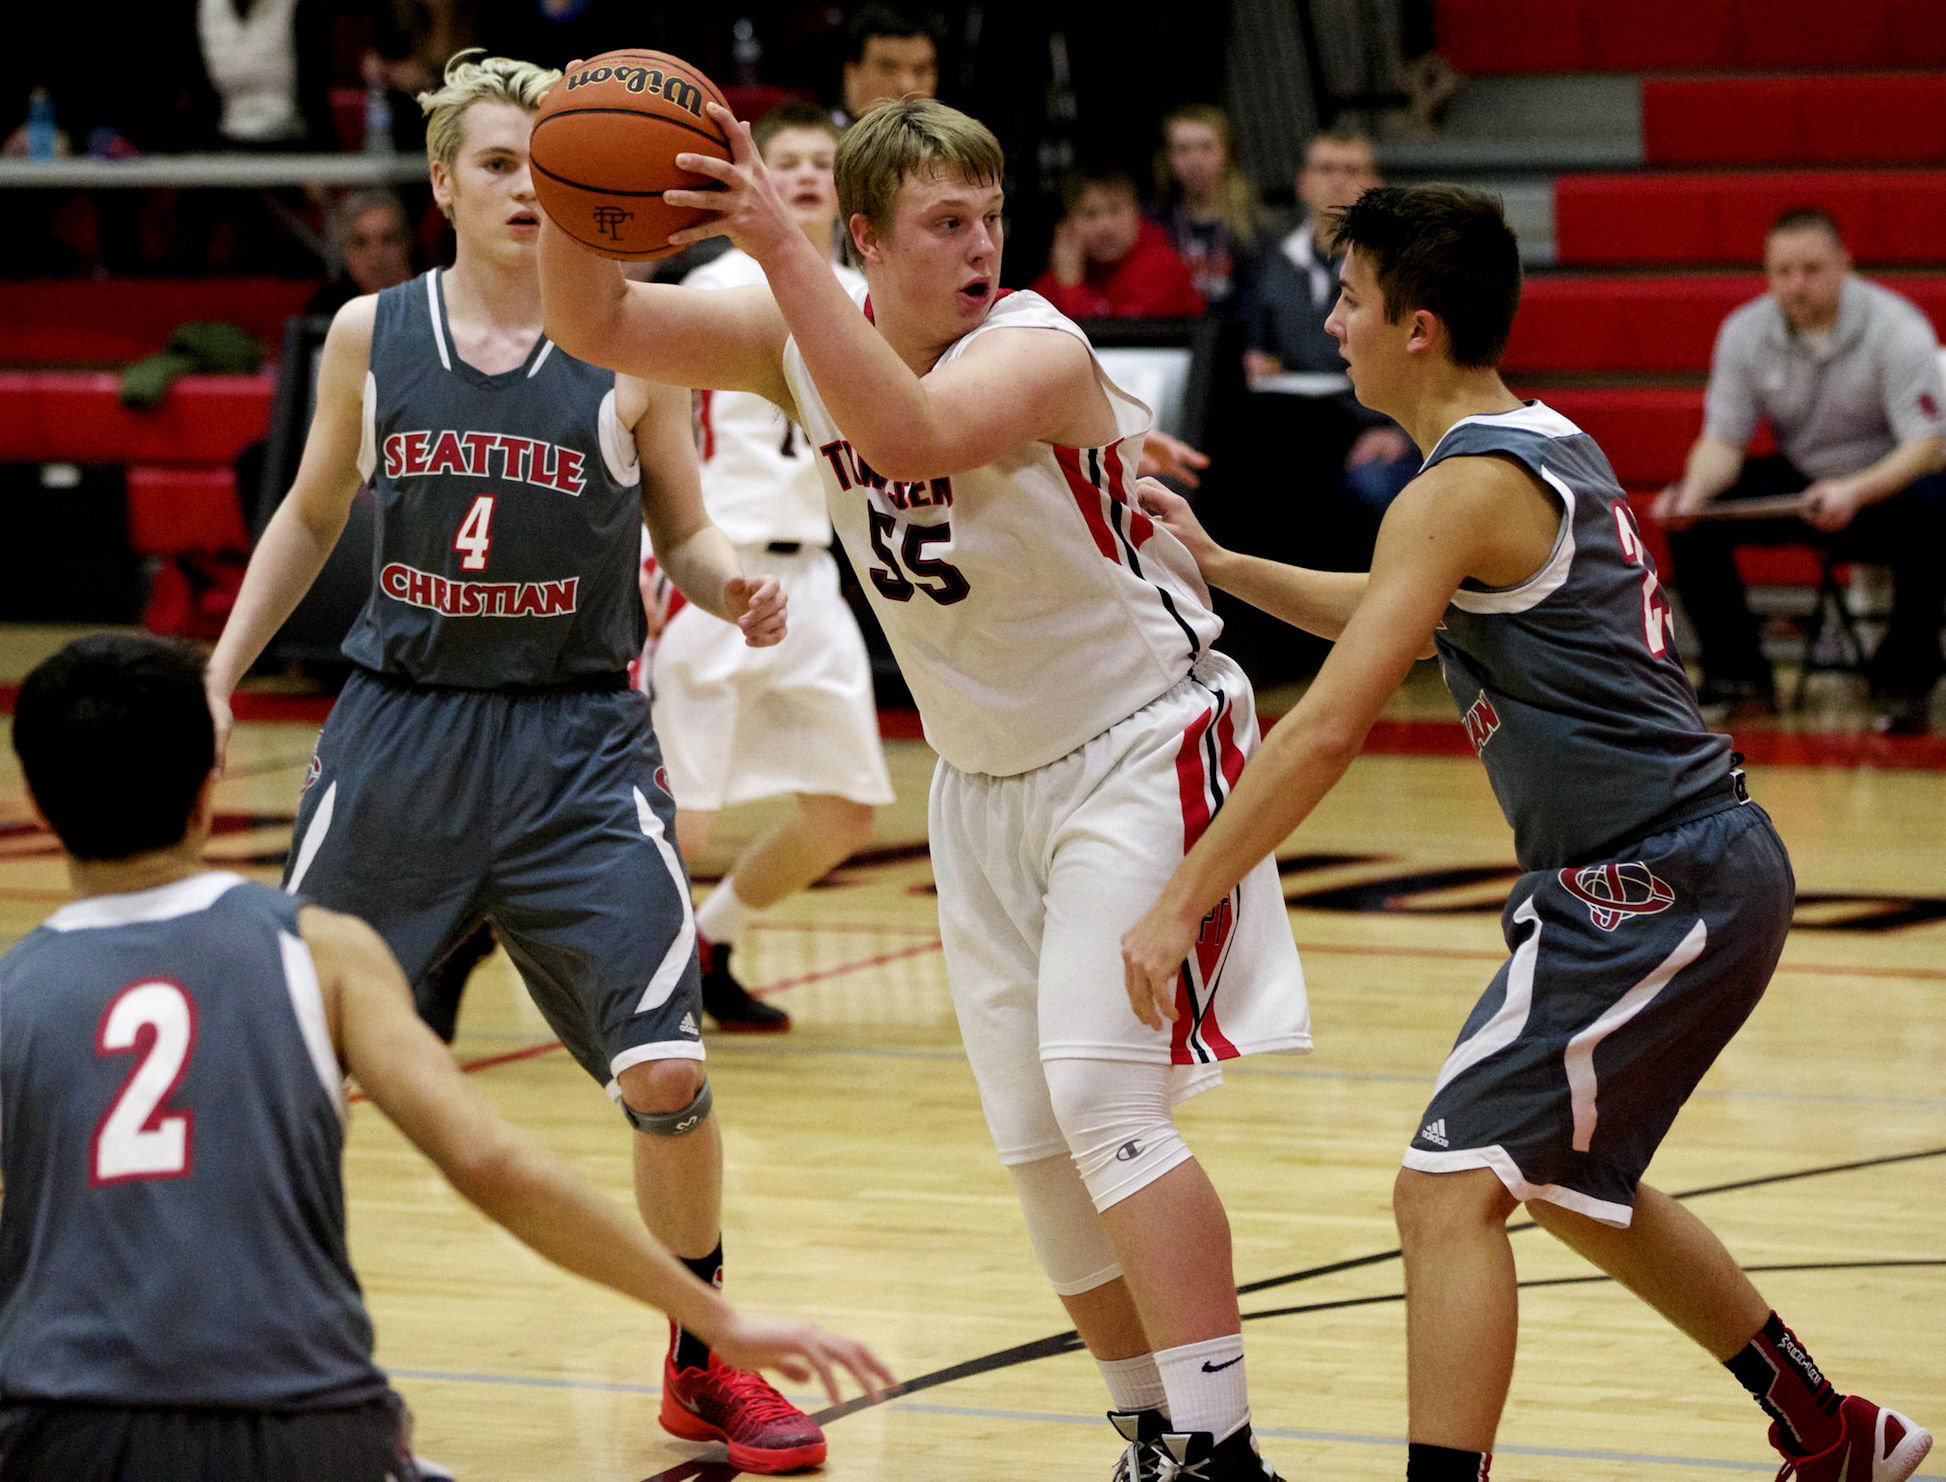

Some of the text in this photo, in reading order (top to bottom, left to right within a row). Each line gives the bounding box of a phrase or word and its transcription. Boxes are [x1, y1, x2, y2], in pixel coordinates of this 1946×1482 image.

[566, 66, 703, 119] Wilson
[383, 430, 587, 497] SEATTLE
[452, 494, 497, 573] 4
[867, 499, 971, 606] 55
[380, 562, 580, 618] CHRISTIAN
[88, 975, 199, 1190] 2
[1421, 1129, 1449, 1148] adidas
